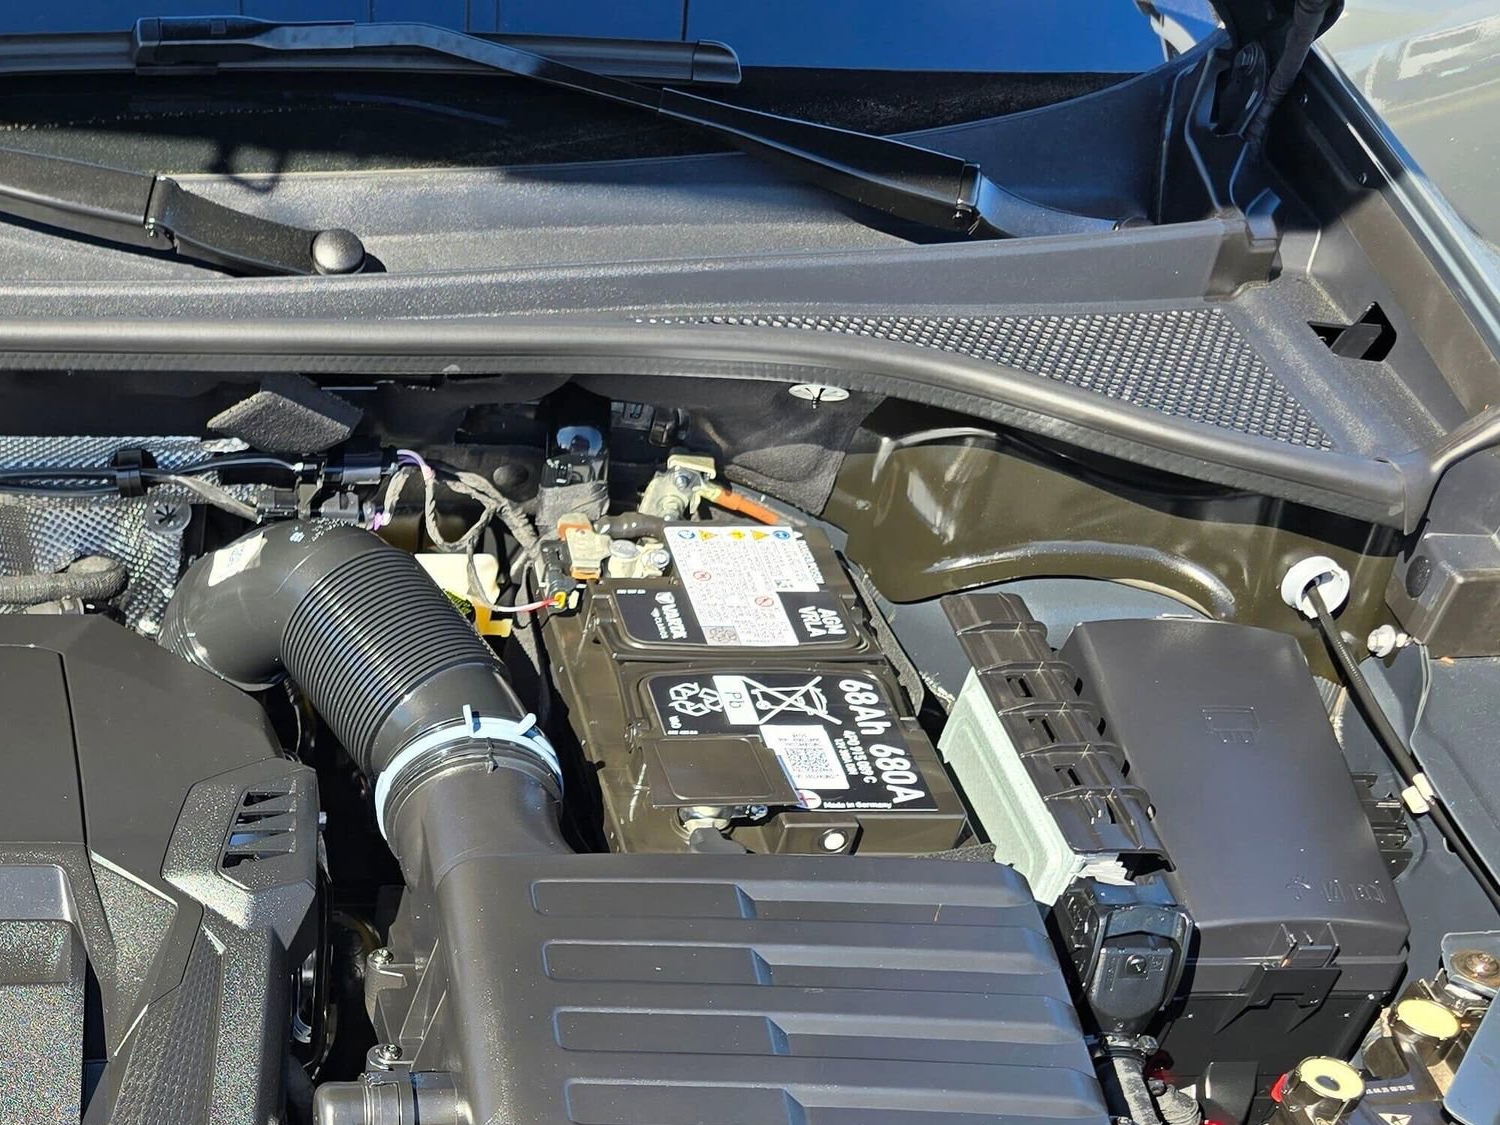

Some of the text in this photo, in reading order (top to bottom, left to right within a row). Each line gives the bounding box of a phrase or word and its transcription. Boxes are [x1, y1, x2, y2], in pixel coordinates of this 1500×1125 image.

[662, 604, 687, 639] VARTA
[799, 606, 830, 638] VRLA
[817, 606, 846, 636] AGM
[724, 692, 744, 708] Pb
[839, 680, 925, 803] 68Ah 680A
